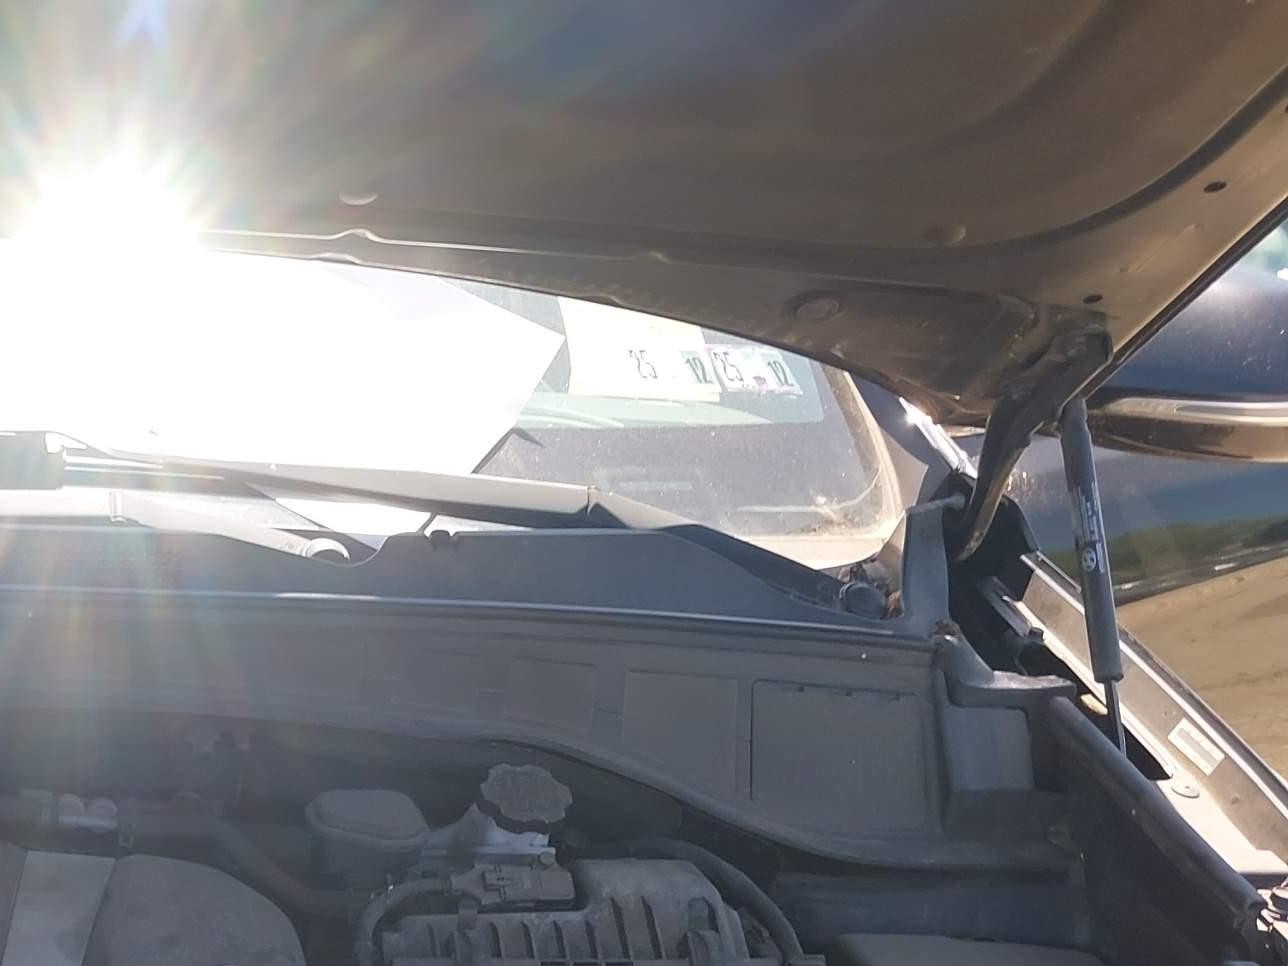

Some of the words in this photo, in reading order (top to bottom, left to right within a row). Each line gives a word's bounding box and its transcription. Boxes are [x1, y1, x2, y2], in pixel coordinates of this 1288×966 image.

[628, 349, 658, 379] 25
[684, 357, 714, 384] 12
[767, 360, 795, 387] 12
